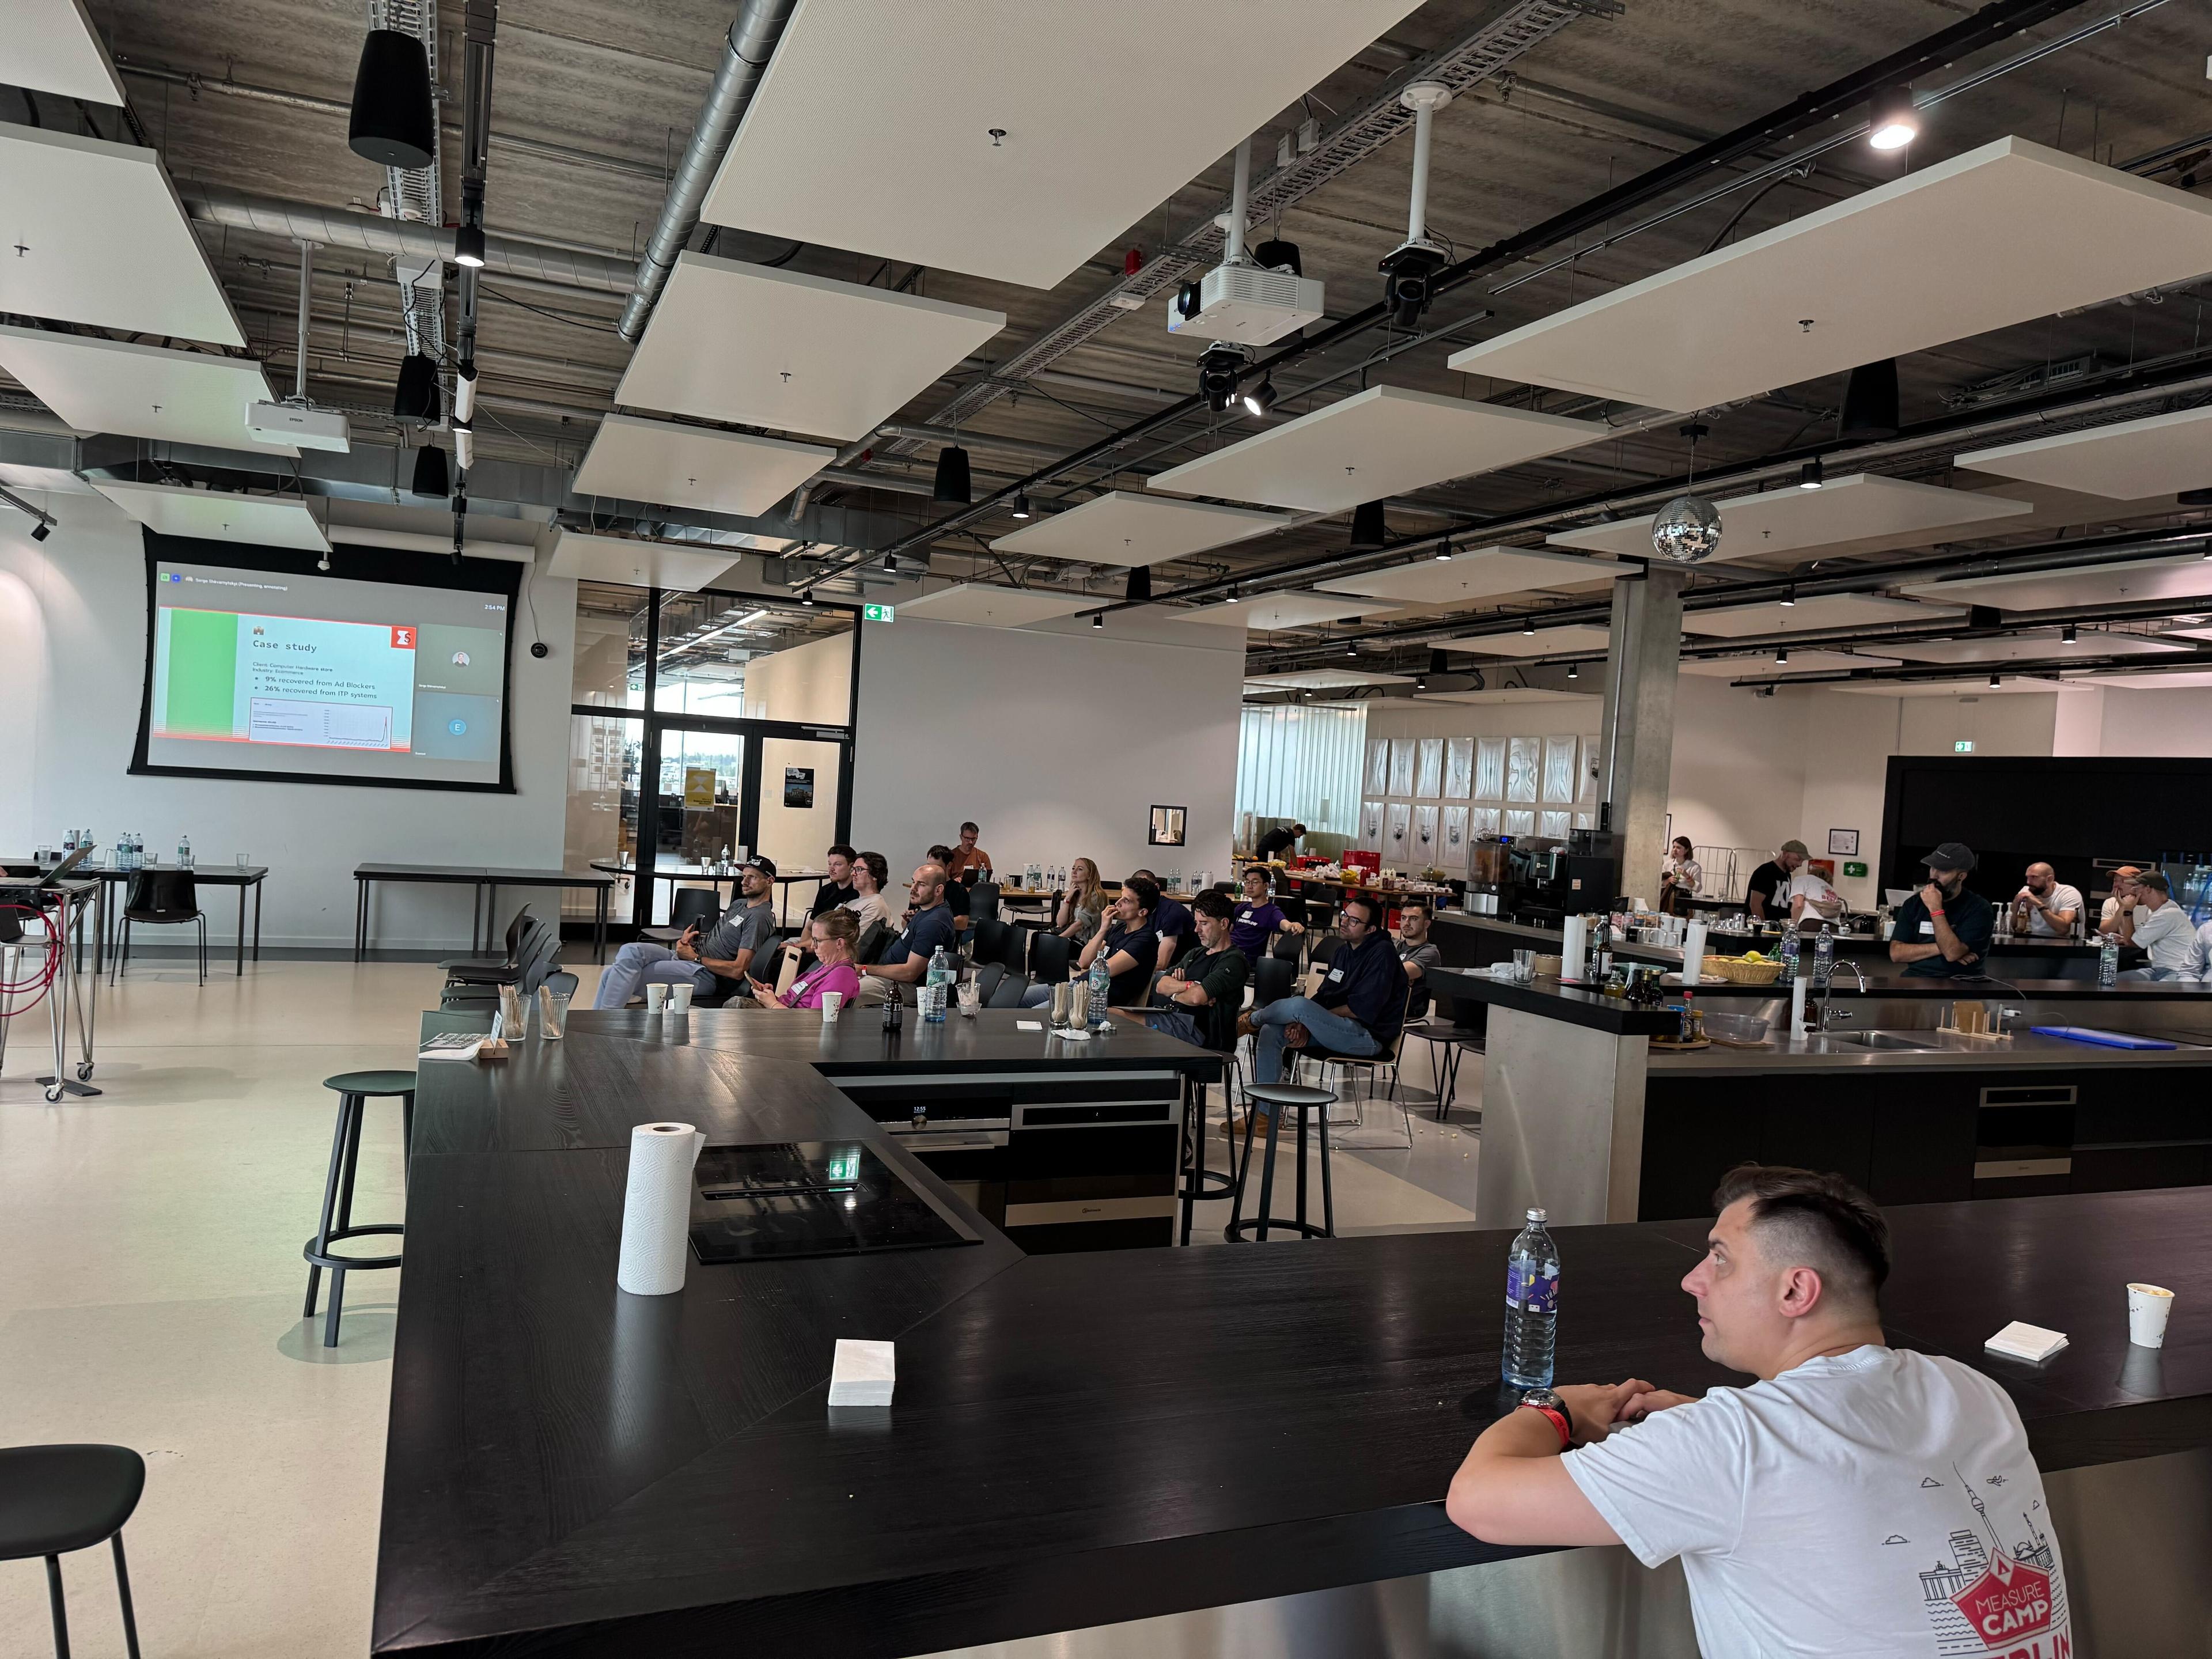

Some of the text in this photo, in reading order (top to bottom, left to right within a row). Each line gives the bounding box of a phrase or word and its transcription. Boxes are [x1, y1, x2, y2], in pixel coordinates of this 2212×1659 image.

[253, 640, 317, 653] Case study
[279, 677, 314, 685] recovered
[346, 681, 375, 690] Blockers
[282, 687, 317, 695] recovered
[350, 691, 377, 699] systems
[1975, 1581, 2044, 1615] MEASURE
[1982, 1599, 2048, 1635] CAMP
